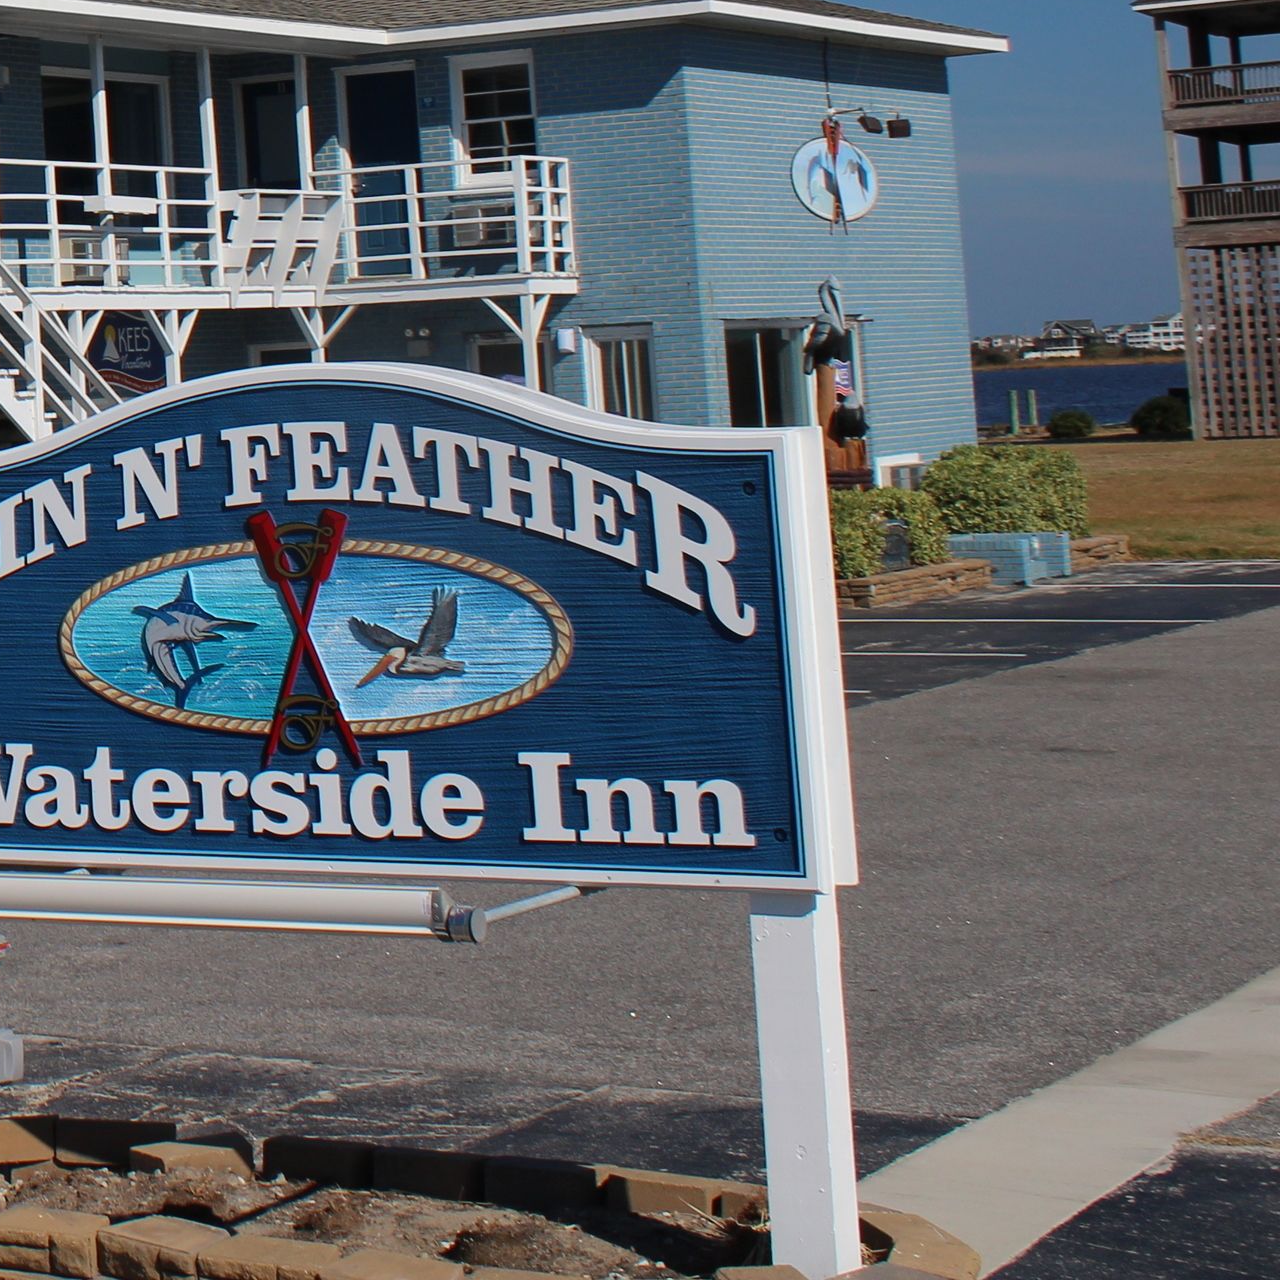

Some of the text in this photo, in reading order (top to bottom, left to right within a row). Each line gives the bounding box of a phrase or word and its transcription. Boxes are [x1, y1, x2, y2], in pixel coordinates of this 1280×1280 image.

[118, 326, 151, 352] KEES
[220, 421, 756, 638] FEATHER
[518, 752, 756, 847] Inn
